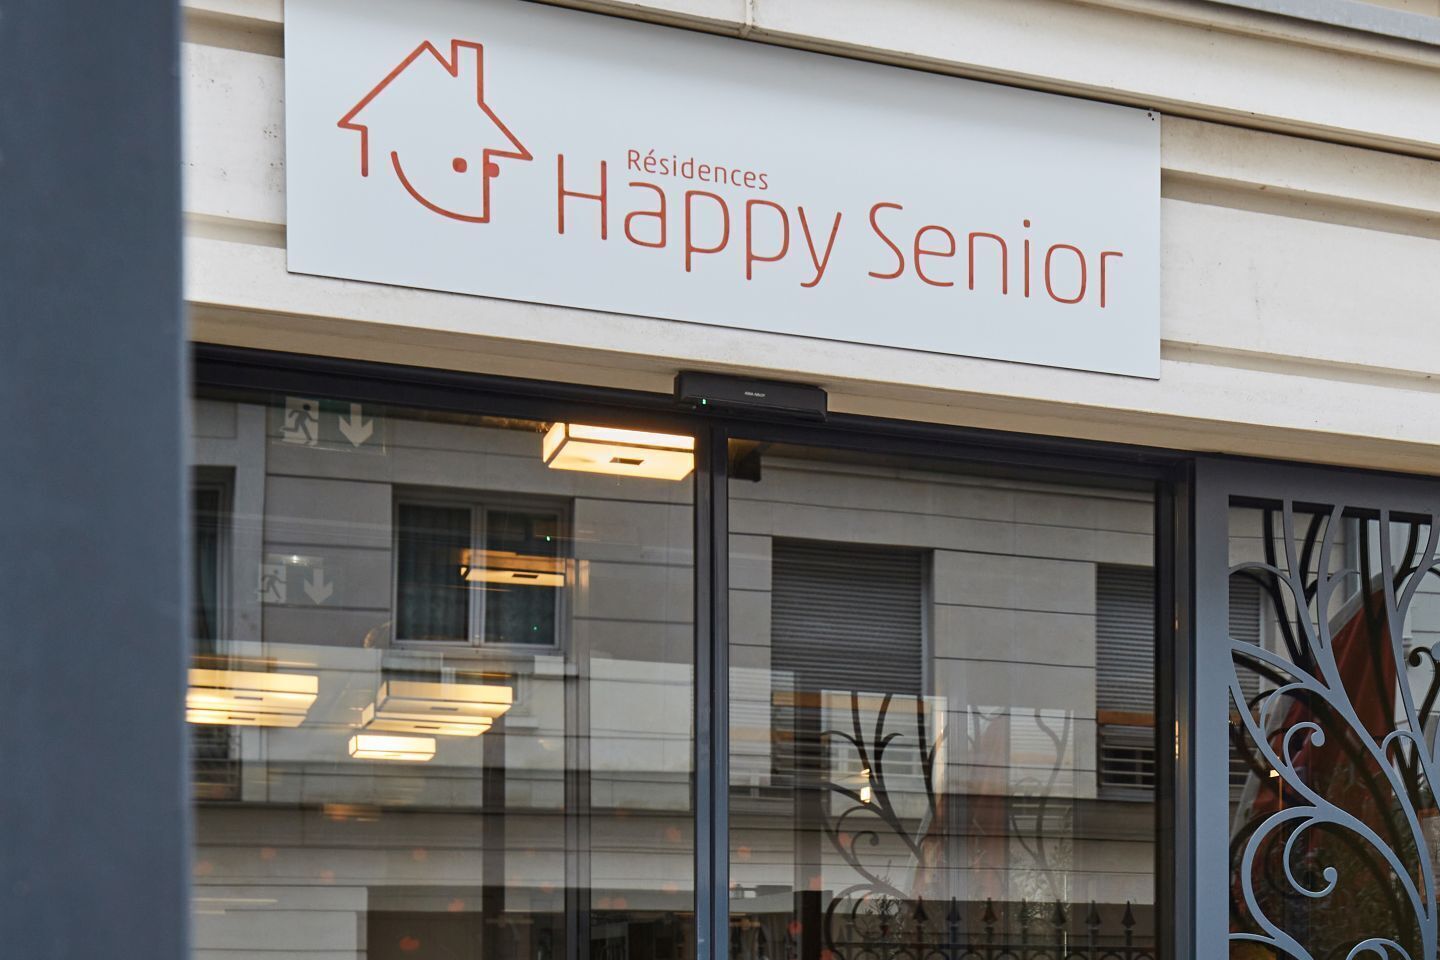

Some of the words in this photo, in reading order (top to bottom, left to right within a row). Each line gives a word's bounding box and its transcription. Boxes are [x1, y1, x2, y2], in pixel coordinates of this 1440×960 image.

[627, 149, 768, 191] Résidences
[556, 152, 843, 289] Happy
[868, 201, 1124, 309] Senior
